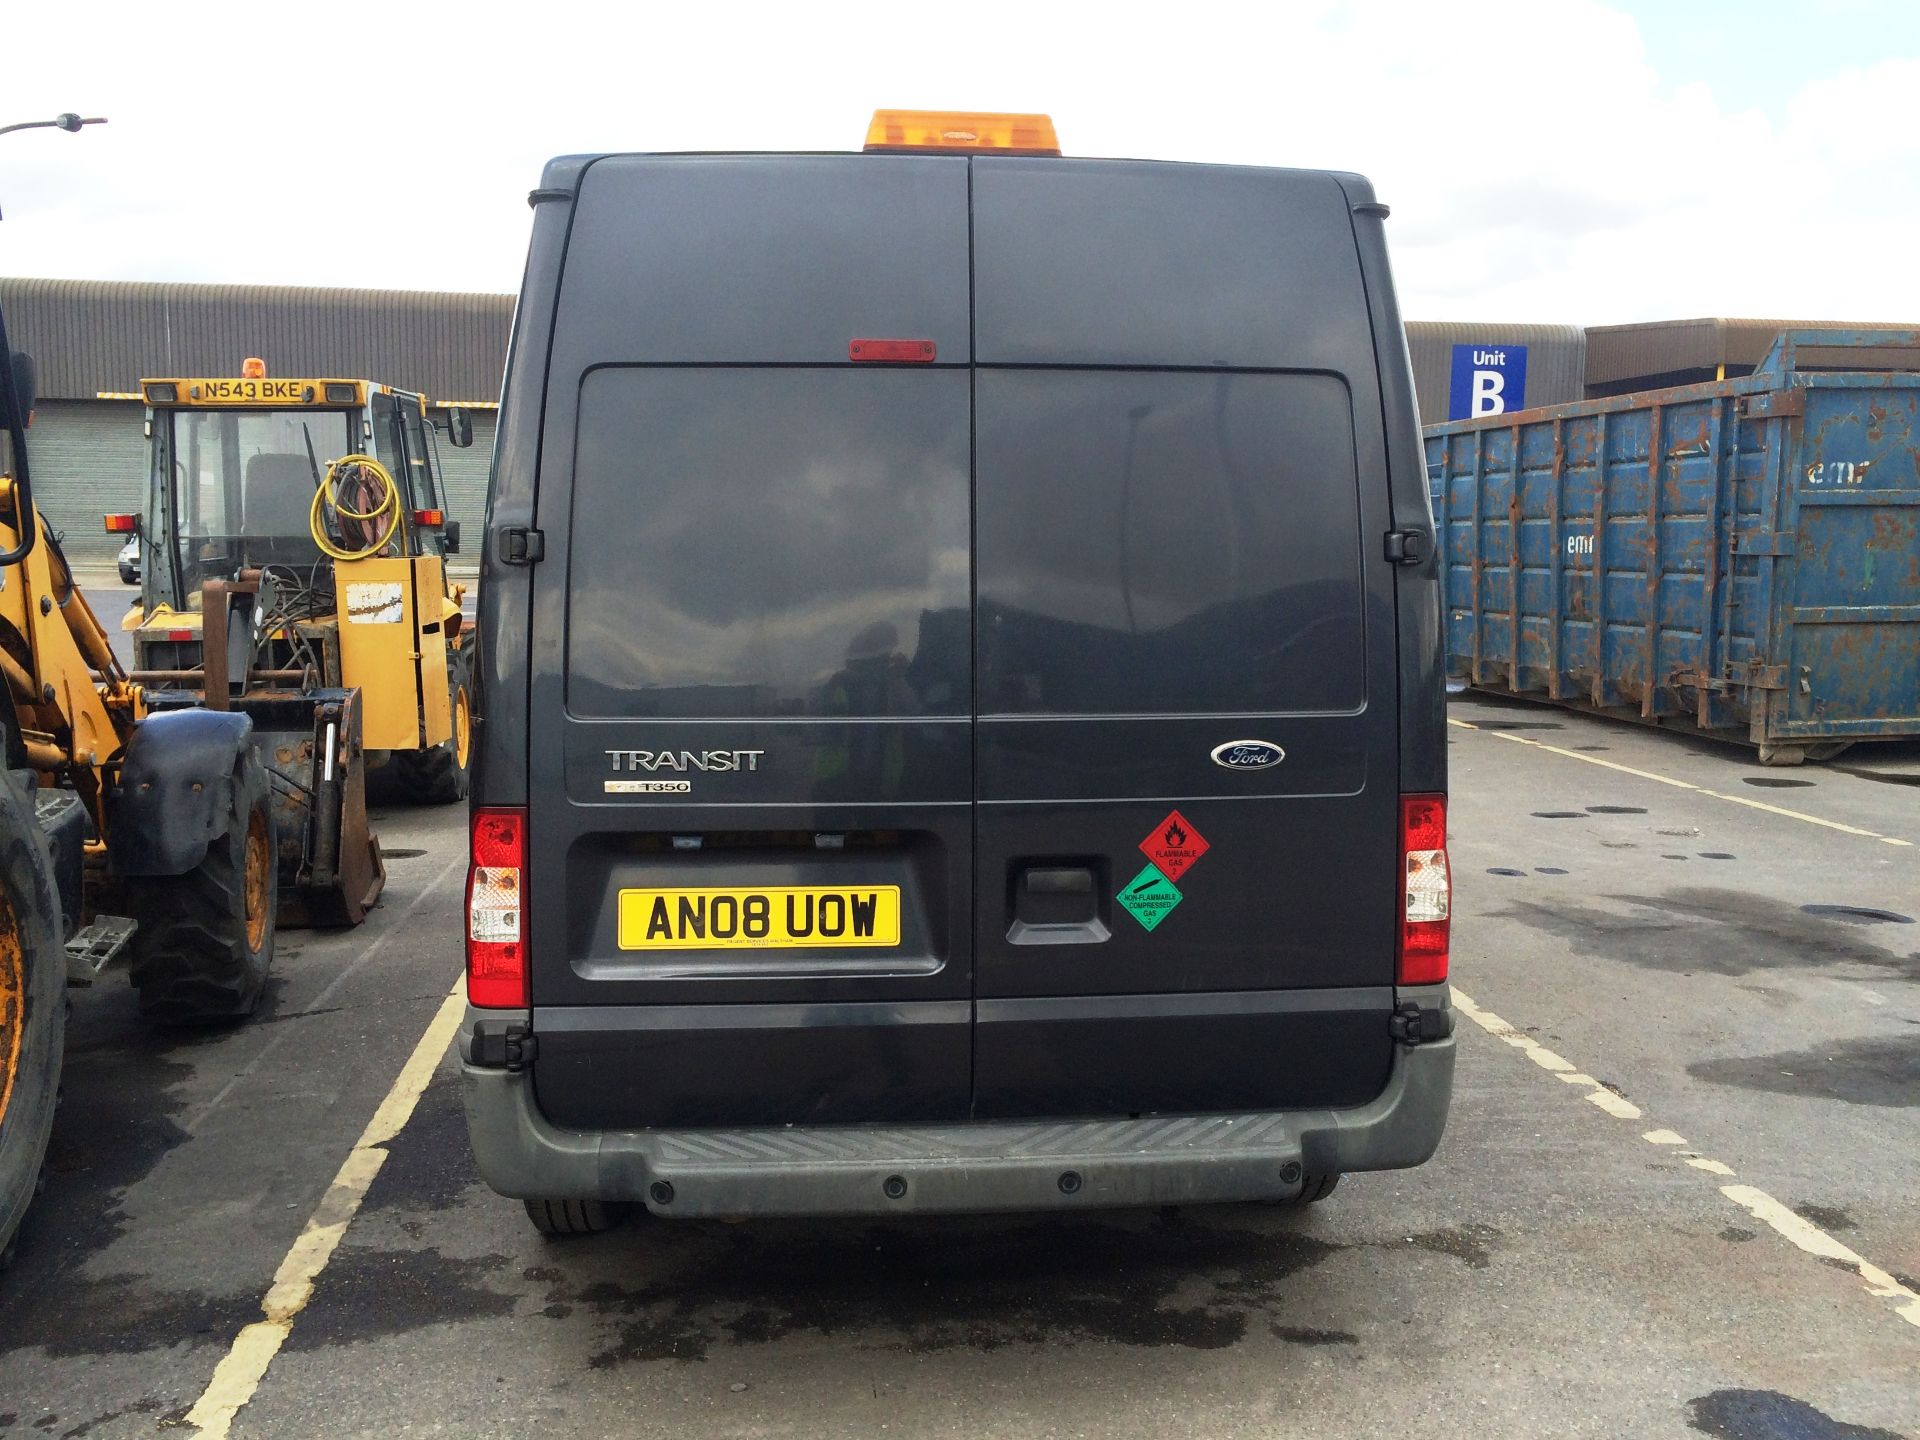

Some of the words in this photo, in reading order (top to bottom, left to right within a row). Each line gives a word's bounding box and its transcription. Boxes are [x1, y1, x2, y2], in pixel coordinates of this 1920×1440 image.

[1473, 350, 1505, 366] Unit
[205, 382, 256, 398] N543
[262, 382, 301, 398] BKE
[1471, 370, 1505, 419] B
[1807, 459, 1871, 485] emr
[1567, 534, 1595, 554] emr
[604, 750, 765, 772] TRANSIT
[1229, 746, 1270, 764] Ford
[641, 783, 689, 792] T350
[1155, 849, 1197, 858] FLAMMABLE
[1168, 858, 1183, 867] GAS
[1171, 867, 1177, 875] 2
[1124, 893, 1177, 901] NON-FLAMMABLE
[1129, 901, 1171, 909] COMPRESSED
[646, 895, 770, 939] AN08
[786, 893, 877, 938] UOW
[1143, 909, 1157, 917] GAS
